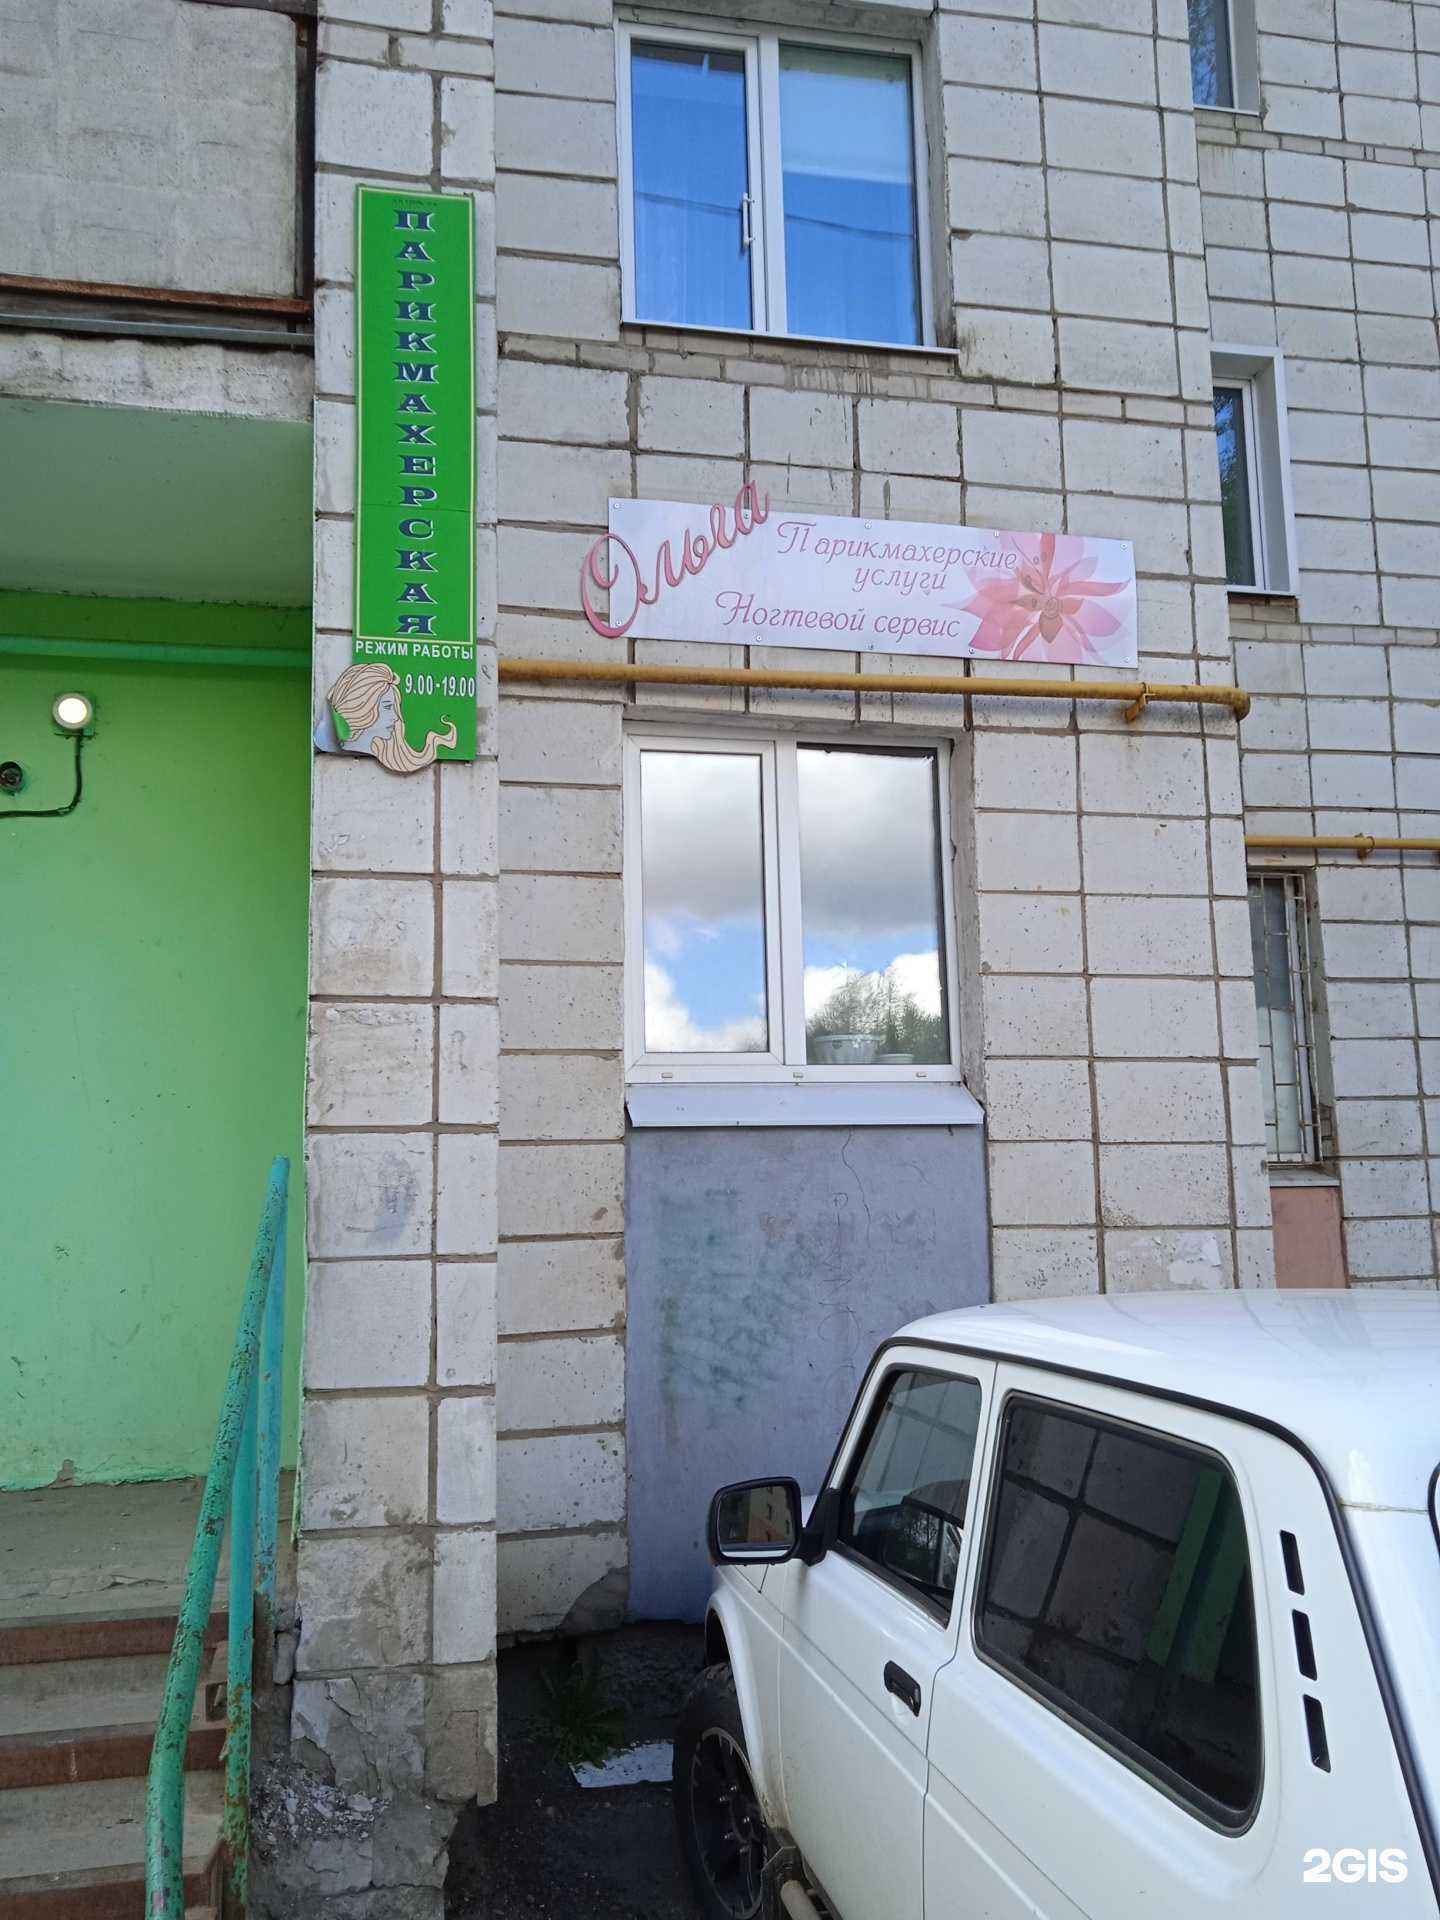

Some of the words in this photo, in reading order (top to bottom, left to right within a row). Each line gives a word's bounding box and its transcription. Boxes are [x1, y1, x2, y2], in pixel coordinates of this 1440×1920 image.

[394, 209, 439, 636] ПАРИКМАХЕРСКАЯ
[581, 480, 769, 638] Ольга
[777, 520, 1018, 570] Парикмахерские
[852, 566, 947, 596] услуги
[715, 590, 865, 631] Ногтевой
[874, 613, 961, 643] сервис
[355, 640, 408, 656] РЕЖИМ
[412, 643, 473, 660] РАБОТЫ
[405, 673, 476, 697] 9.00-19.00
